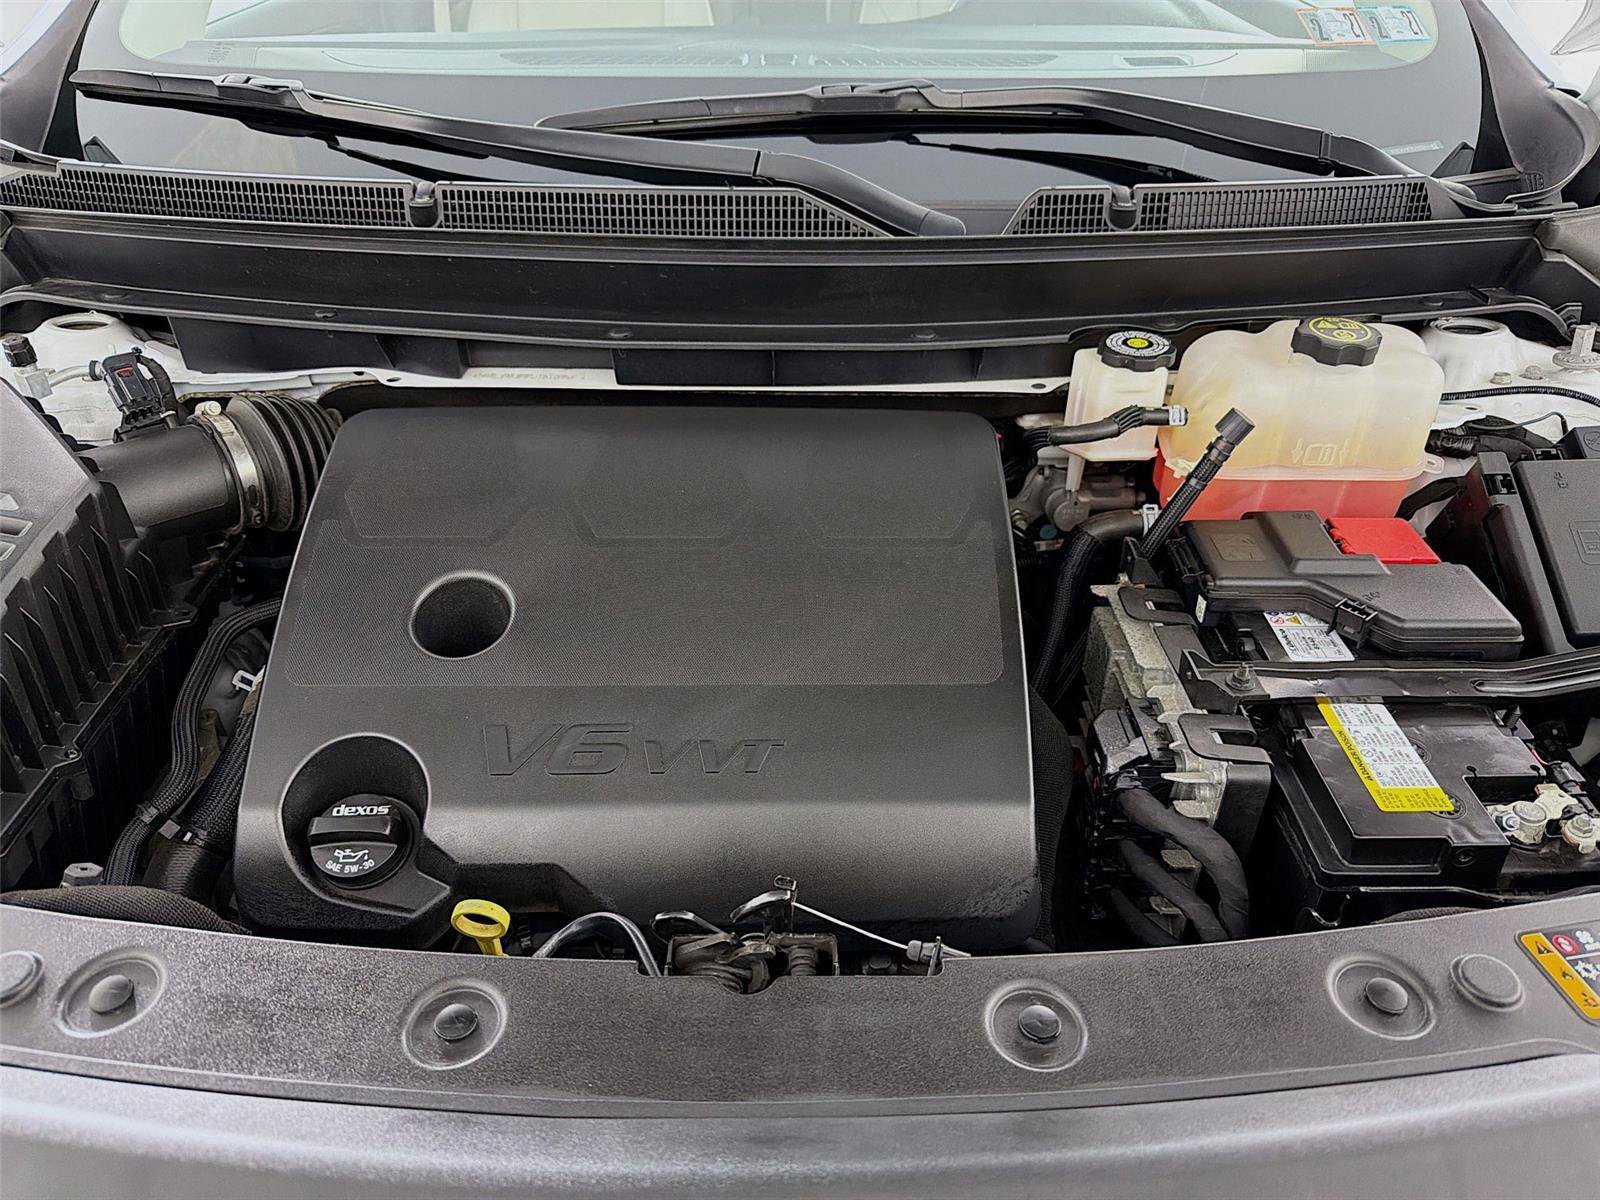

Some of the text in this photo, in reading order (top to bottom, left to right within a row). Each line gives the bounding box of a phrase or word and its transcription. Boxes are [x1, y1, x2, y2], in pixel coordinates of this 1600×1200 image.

[483, 723, 786, 775] V6 VVT
[1350, 751, 1370, 777] DANGER
[332, 804, 391, 816] dexos
[325, 859, 375, 873] SAE 5W-30
